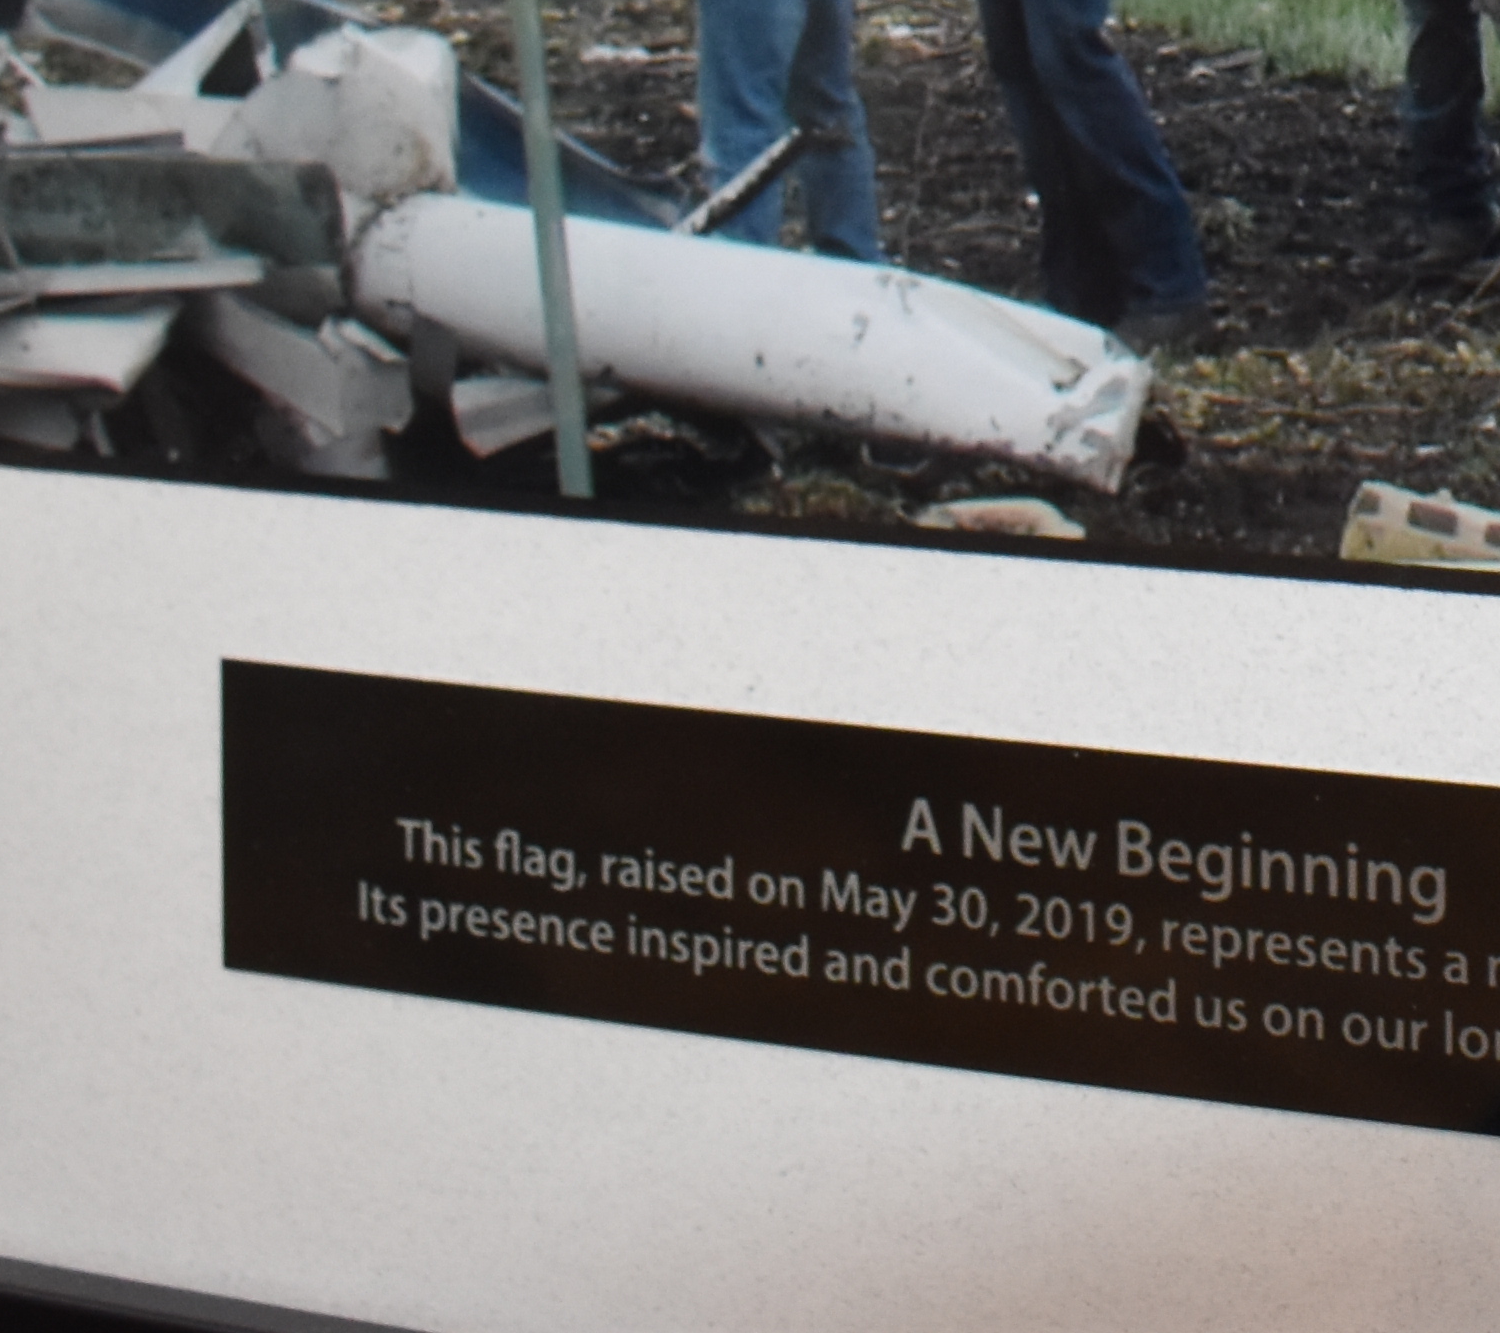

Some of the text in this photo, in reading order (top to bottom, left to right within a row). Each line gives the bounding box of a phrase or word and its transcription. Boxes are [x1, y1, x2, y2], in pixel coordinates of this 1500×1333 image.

[395, 817, 484, 870] This
[493, 827, 587, 893] flag,
[600, 847, 735, 901] raised
[747, 871, 806, 909] on
[820, 868, 918, 933] May
[931, 882, 1000, 938] 30,
[1015, 892, 1146, 955] 2019,
[1162, 919, 1427, 980] represents
[1442, 951, 1469, 985] a
[900, 796, 1447, 926] A New Beginning
[358, 880, 409, 927] Its
[419, 899, 615, 954] presence
[627, 913, 810, 978] inspired
[823, 949, 911, 991] and
[924, 962, 1177, 1024] comforted
[1194, 995, 1248, 1032] us
[1262, 1003, 1325, 1040] on
[1341, 1012, 1428, 1052] our
